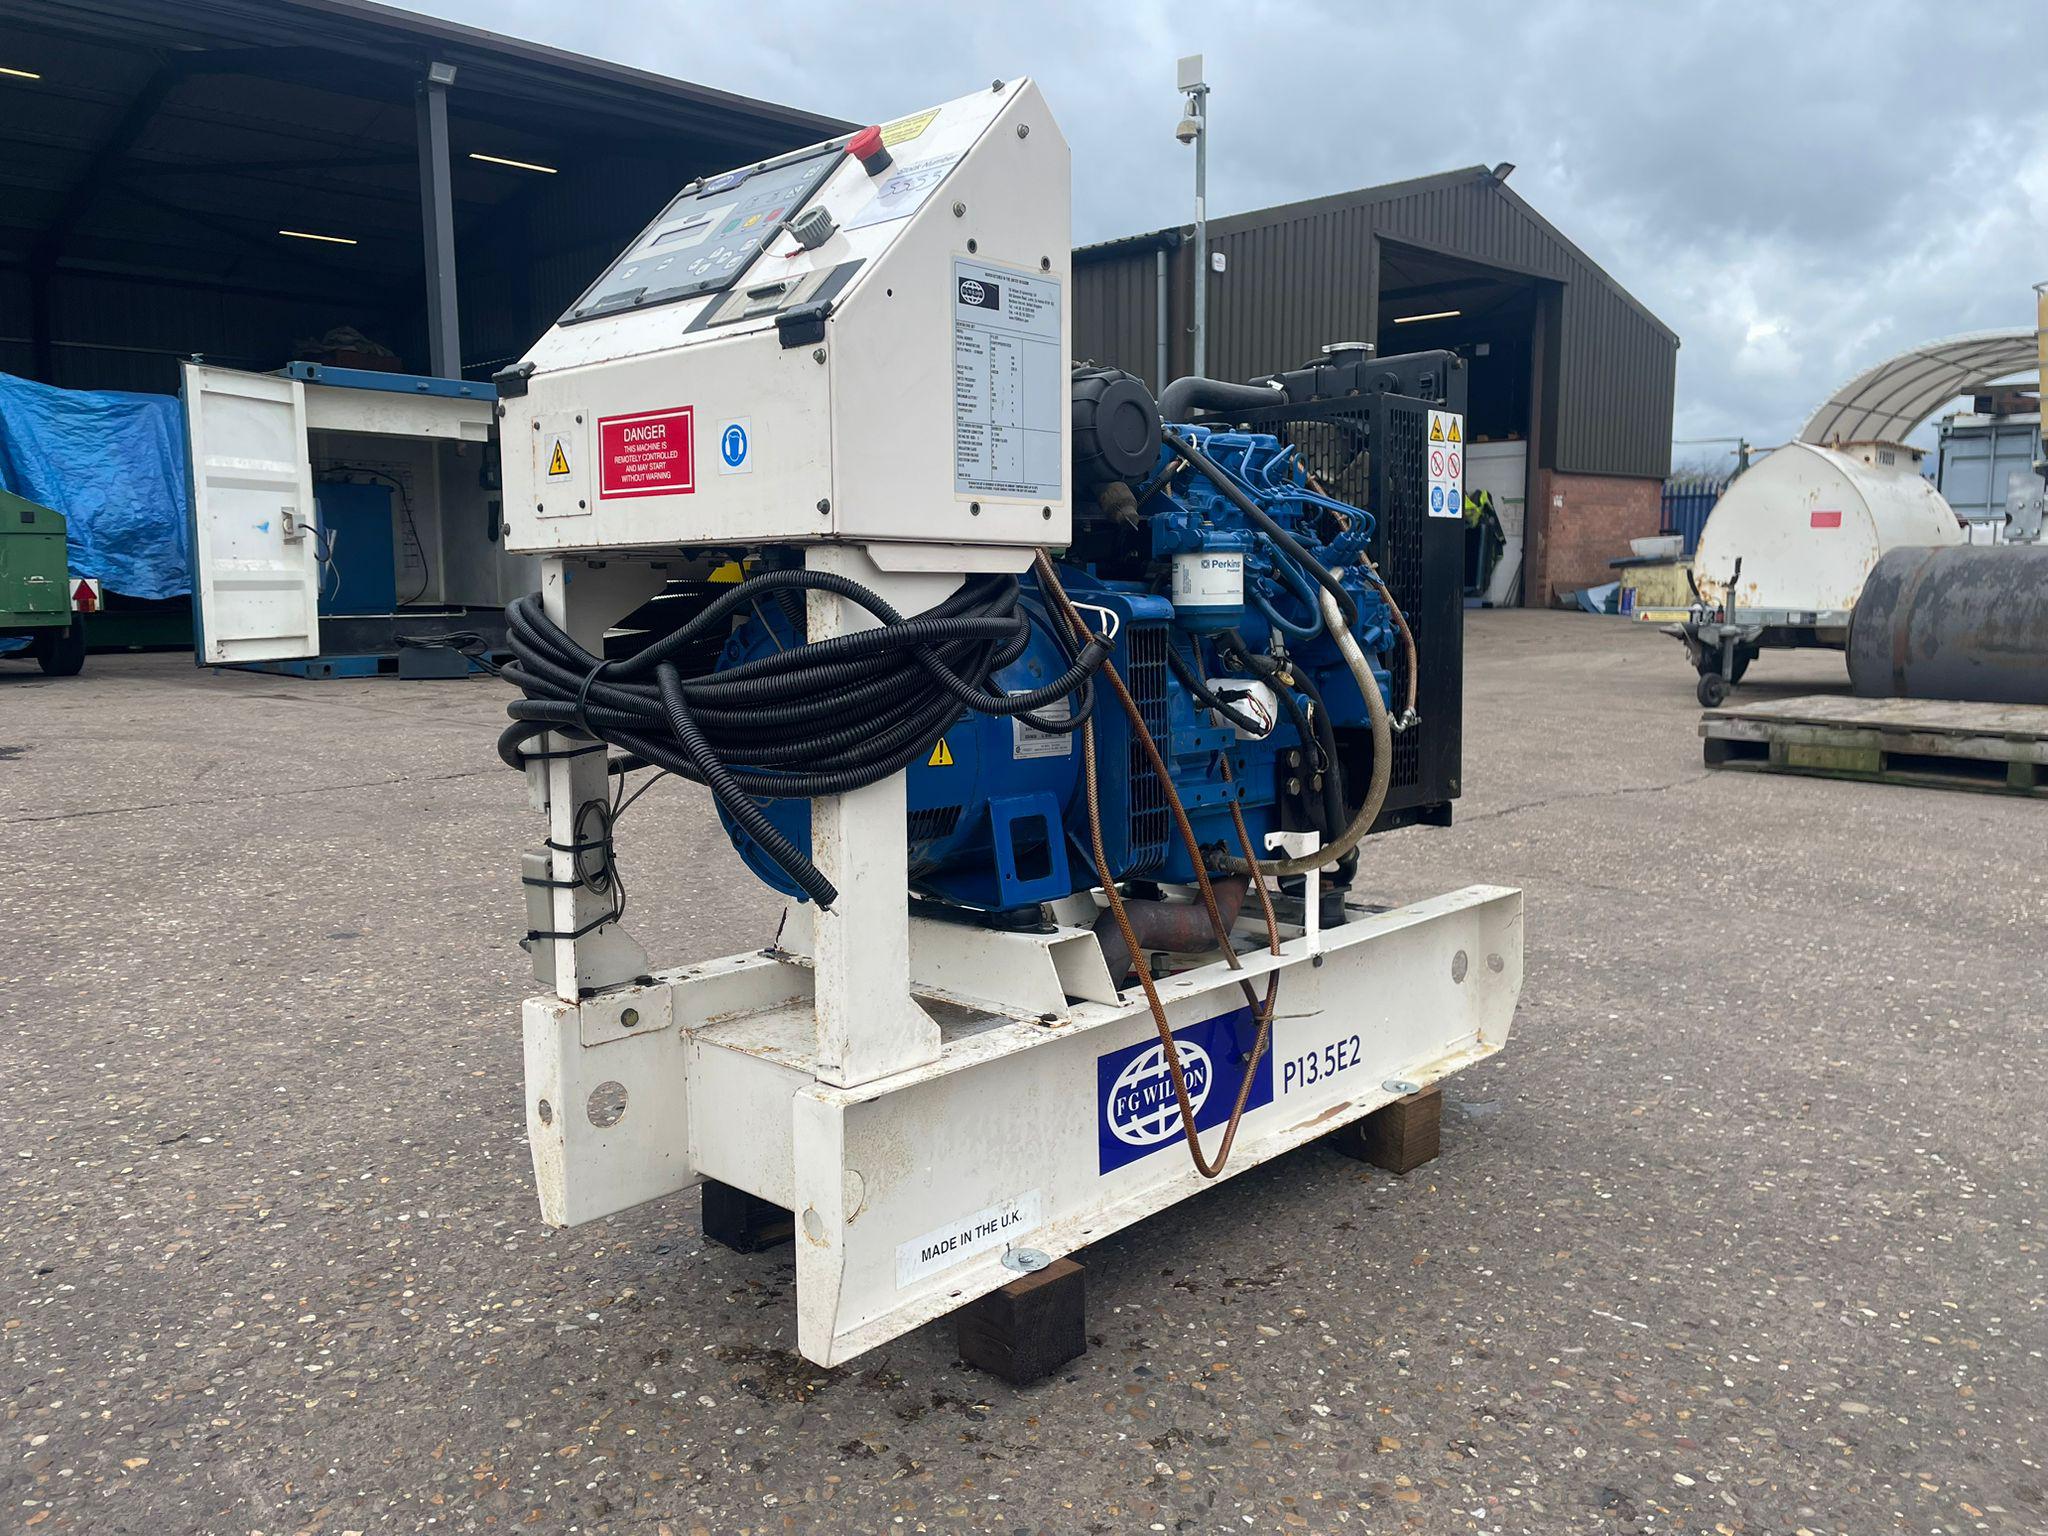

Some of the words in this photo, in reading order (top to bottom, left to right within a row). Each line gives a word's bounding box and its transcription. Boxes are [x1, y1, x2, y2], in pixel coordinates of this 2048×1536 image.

[623, 424, 666, 442] DANGER
[624, 445, 636, 453] THIS
[637, 443, 660, 452] MACHINE
[661, 441, 668, 450] IS
[614, 455, 642, 464] REMOTELY
[642, 450, 678, 461] CONTROLLED
[625, 464, 637, 472] AND
[637, 463, 648, 471] MAY
[649, 462, 667, 470] START
[621, 474, 645, 482] WITHOUT
[646, 471, 671, 480] WARNING
[1211, 559, 1240, 569] Perkins
[1284, 1035, 1361, 1094] P13.5E2
[1116, 1092, 1140, 1117] FG
[1143, 1067, 1204, 1105] WILON
[921, 1236, 957, 1262] MADE
[960, 1230, 972, 1246] IN
[975, 1219, 998, 1238] THE
[1001, 1209, 1023, 1228] U.K.
